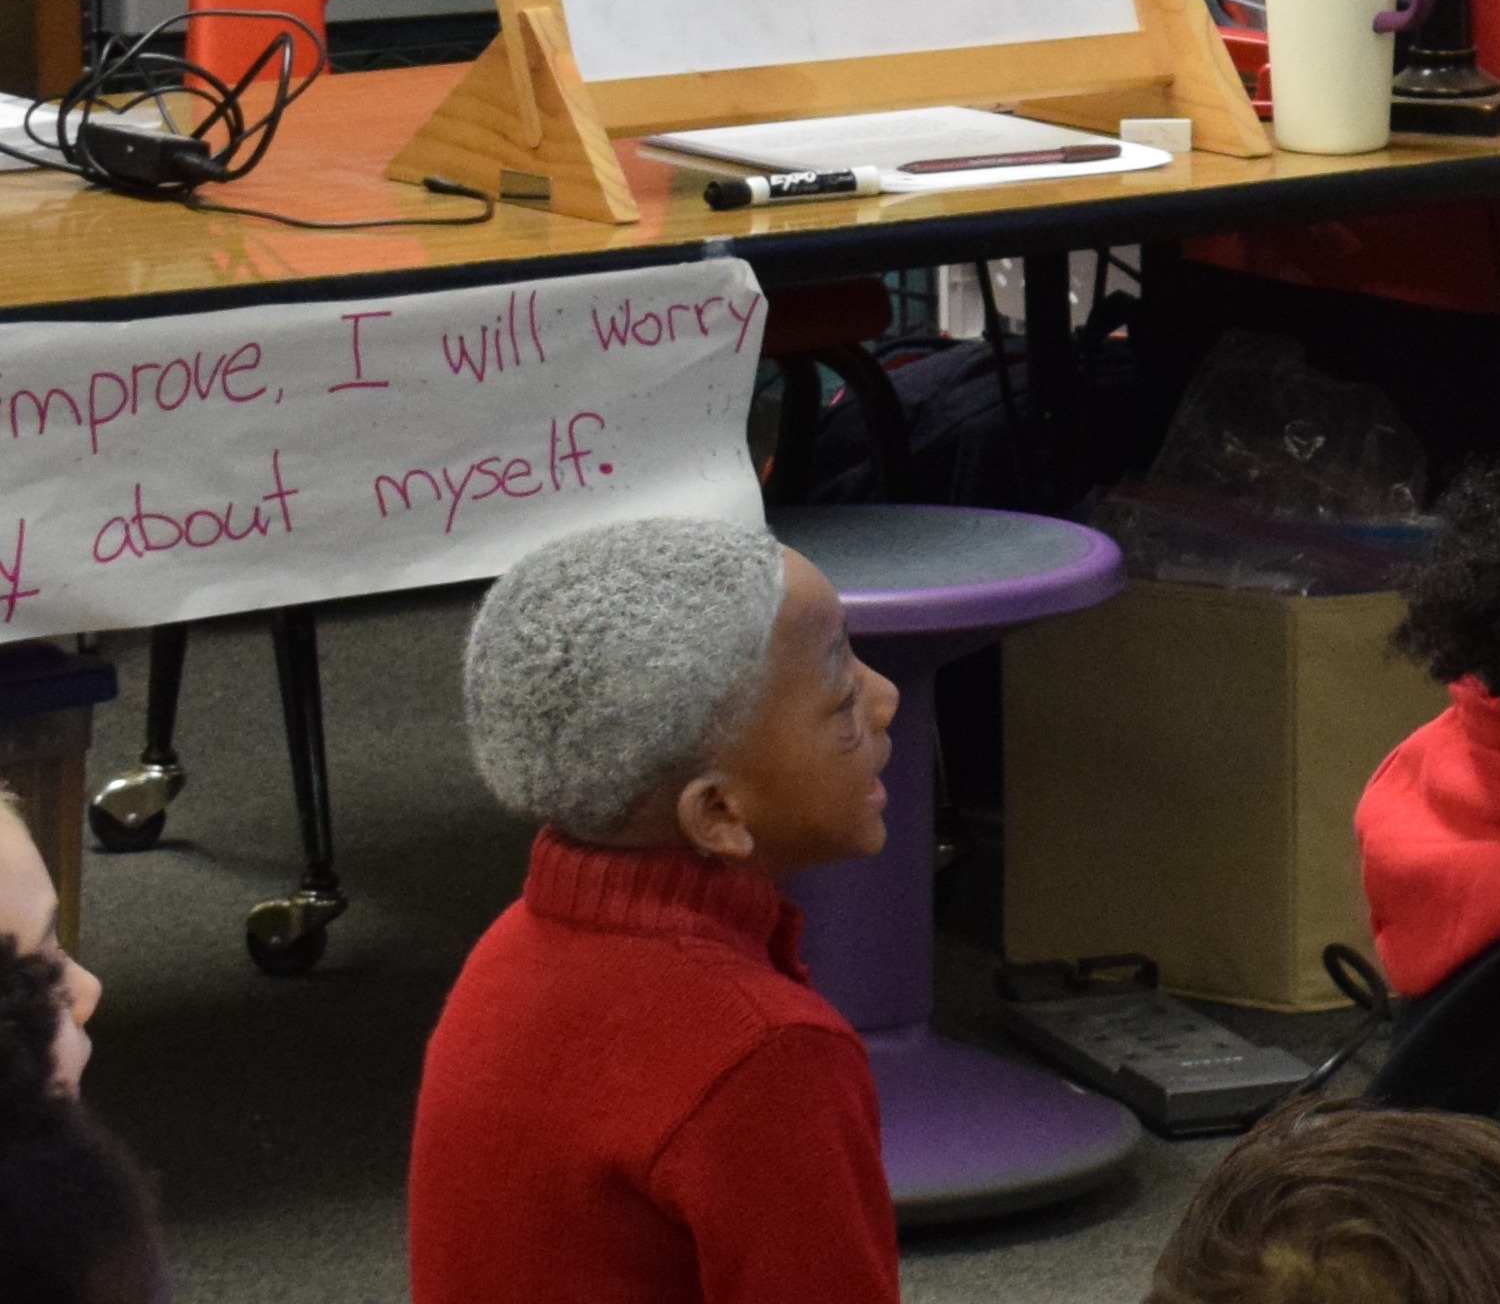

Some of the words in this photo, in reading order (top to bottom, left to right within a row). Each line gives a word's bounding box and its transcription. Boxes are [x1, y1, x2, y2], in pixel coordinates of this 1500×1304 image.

[0, 340, 285, 454] mprove,
[328, 309, 393, 394] I
[441, 290, 545, 383] will
[92, 448, 299, 564] about
[373, 411, 615, 534] myself.
